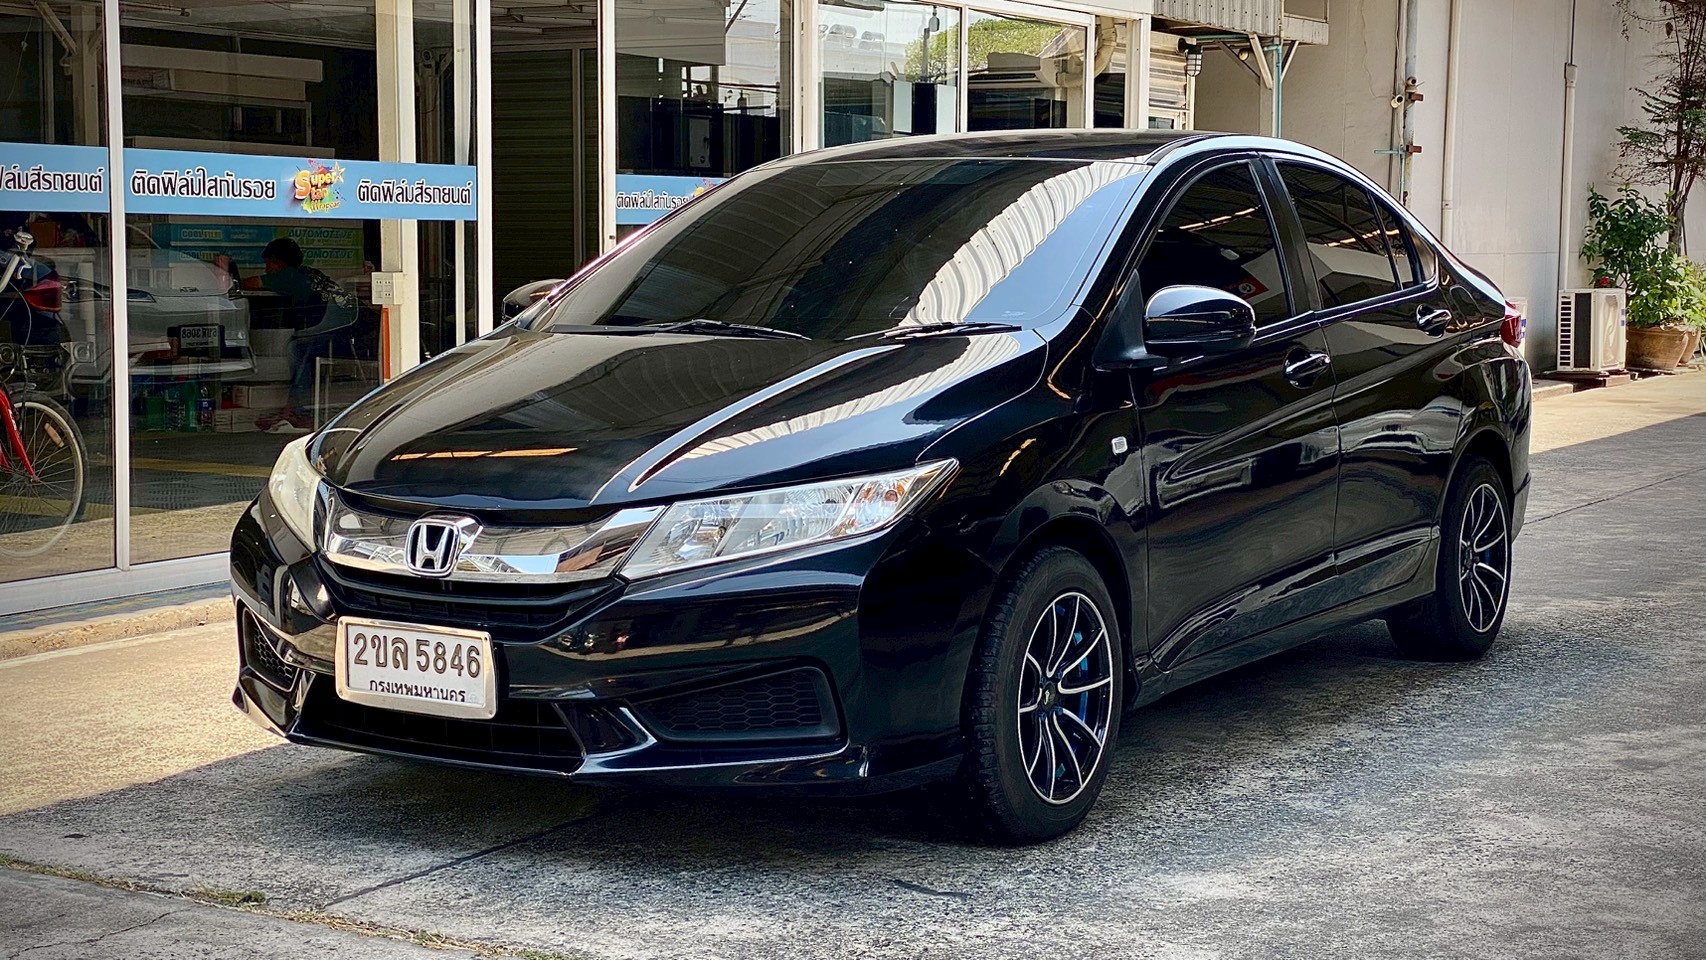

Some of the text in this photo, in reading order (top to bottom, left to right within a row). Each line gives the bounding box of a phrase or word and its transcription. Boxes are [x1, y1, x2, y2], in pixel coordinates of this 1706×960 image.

[131, 167, 275, 198] ติดฟิล์มใสกันรอย
[294, 170, 337, 200] Super
[358, 180, 471, 204] ติดฟิล์มสีรถยนต์
[288, 229, 353, 239] AUTOMOTIVE
[353, 632, 481, 679] 2ขล 5846
